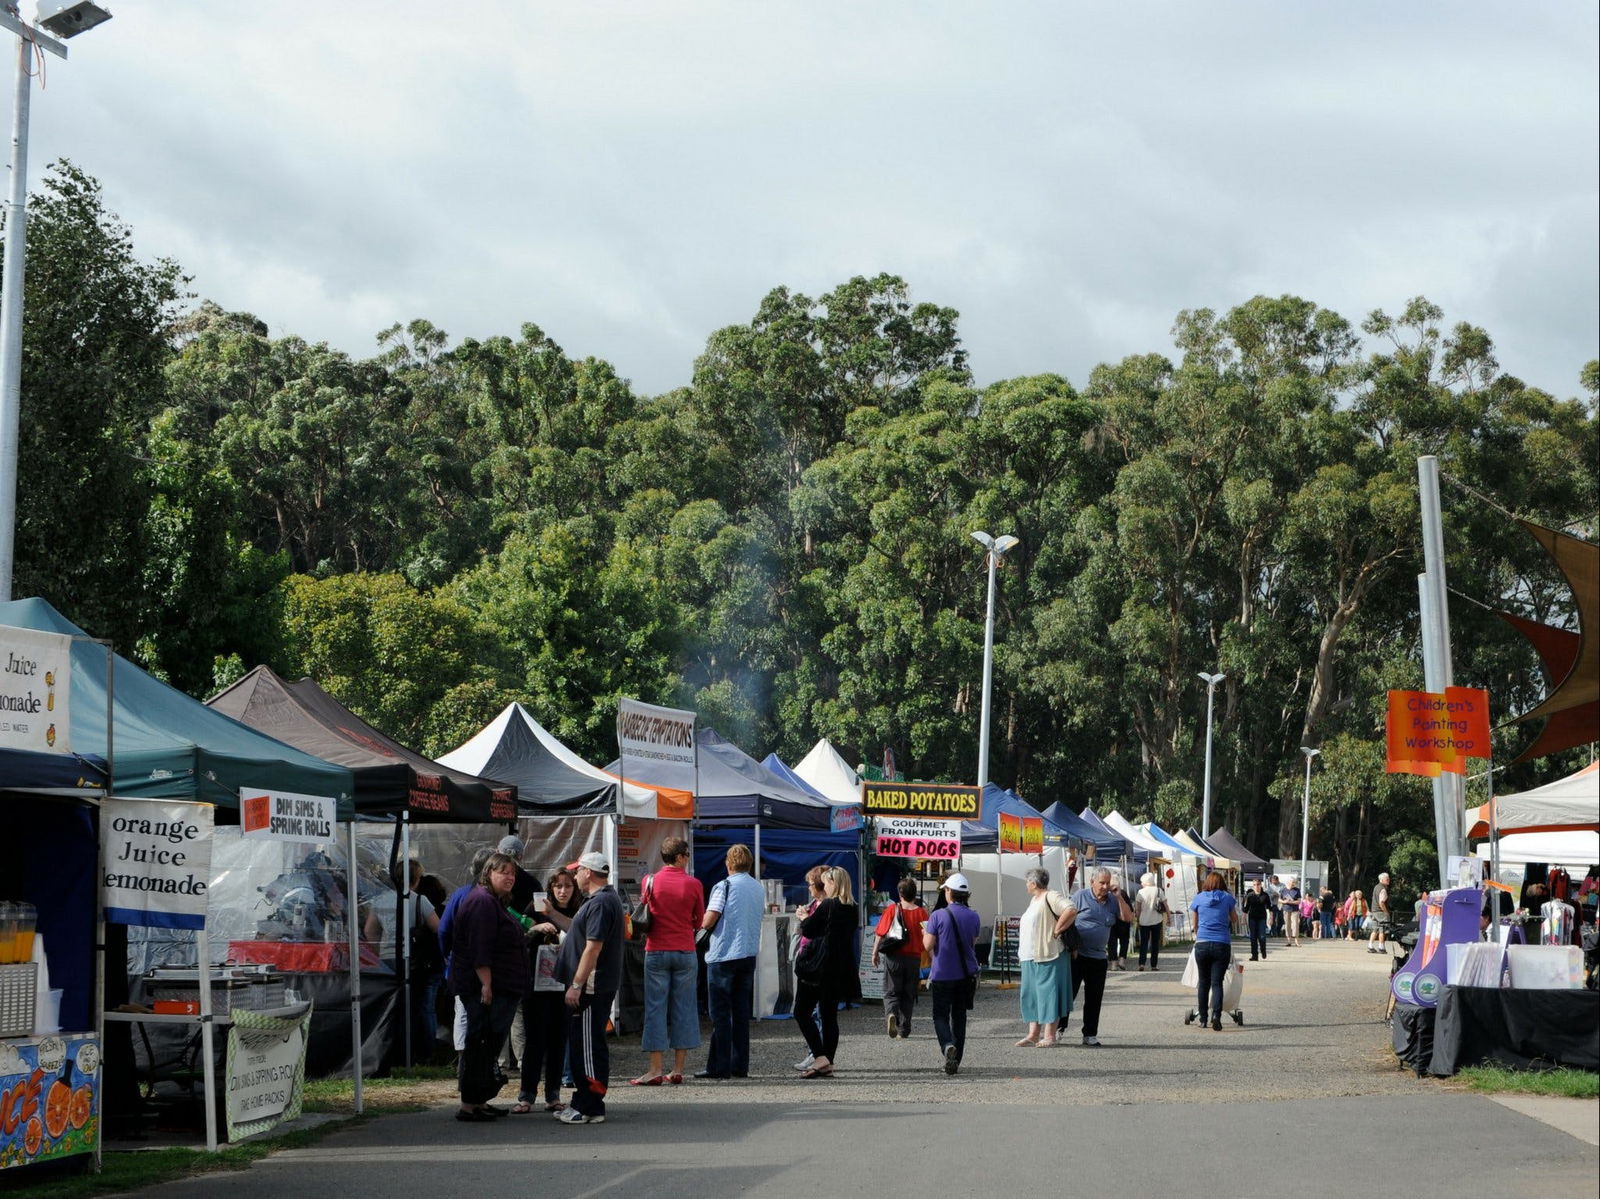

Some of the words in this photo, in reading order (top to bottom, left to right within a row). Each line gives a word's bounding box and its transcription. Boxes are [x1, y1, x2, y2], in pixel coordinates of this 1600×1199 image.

[5, 652, 37, 676] Juice
[1407, 698, 1475, 712] Children's
[1412, 718, 1468, 734] Painting
[1405, 737, 1475, 750] Workshop
[276, 798, 293, 816] DIM
[295, 800, 315, 818] SIMS
[317, 803, 324, 819] &
[867, 790, 907, 809] BAKED
[910, 792, 976, 812] POTATOES
[112, 817, 199, 843] orange
[270, 816, 303, 836] SPRING
[305, 819, 331, 838] ROLLS
[881, 828, 956, 837] FRANKFURTS
[892, 820, 947, 828] GOURMET
[118, 841, 186, 866] Juice
[880, 839, 912, 854] HOT
[915, 841, 957, 857] DOGS
[102, 866, 207, 896] lemonade
